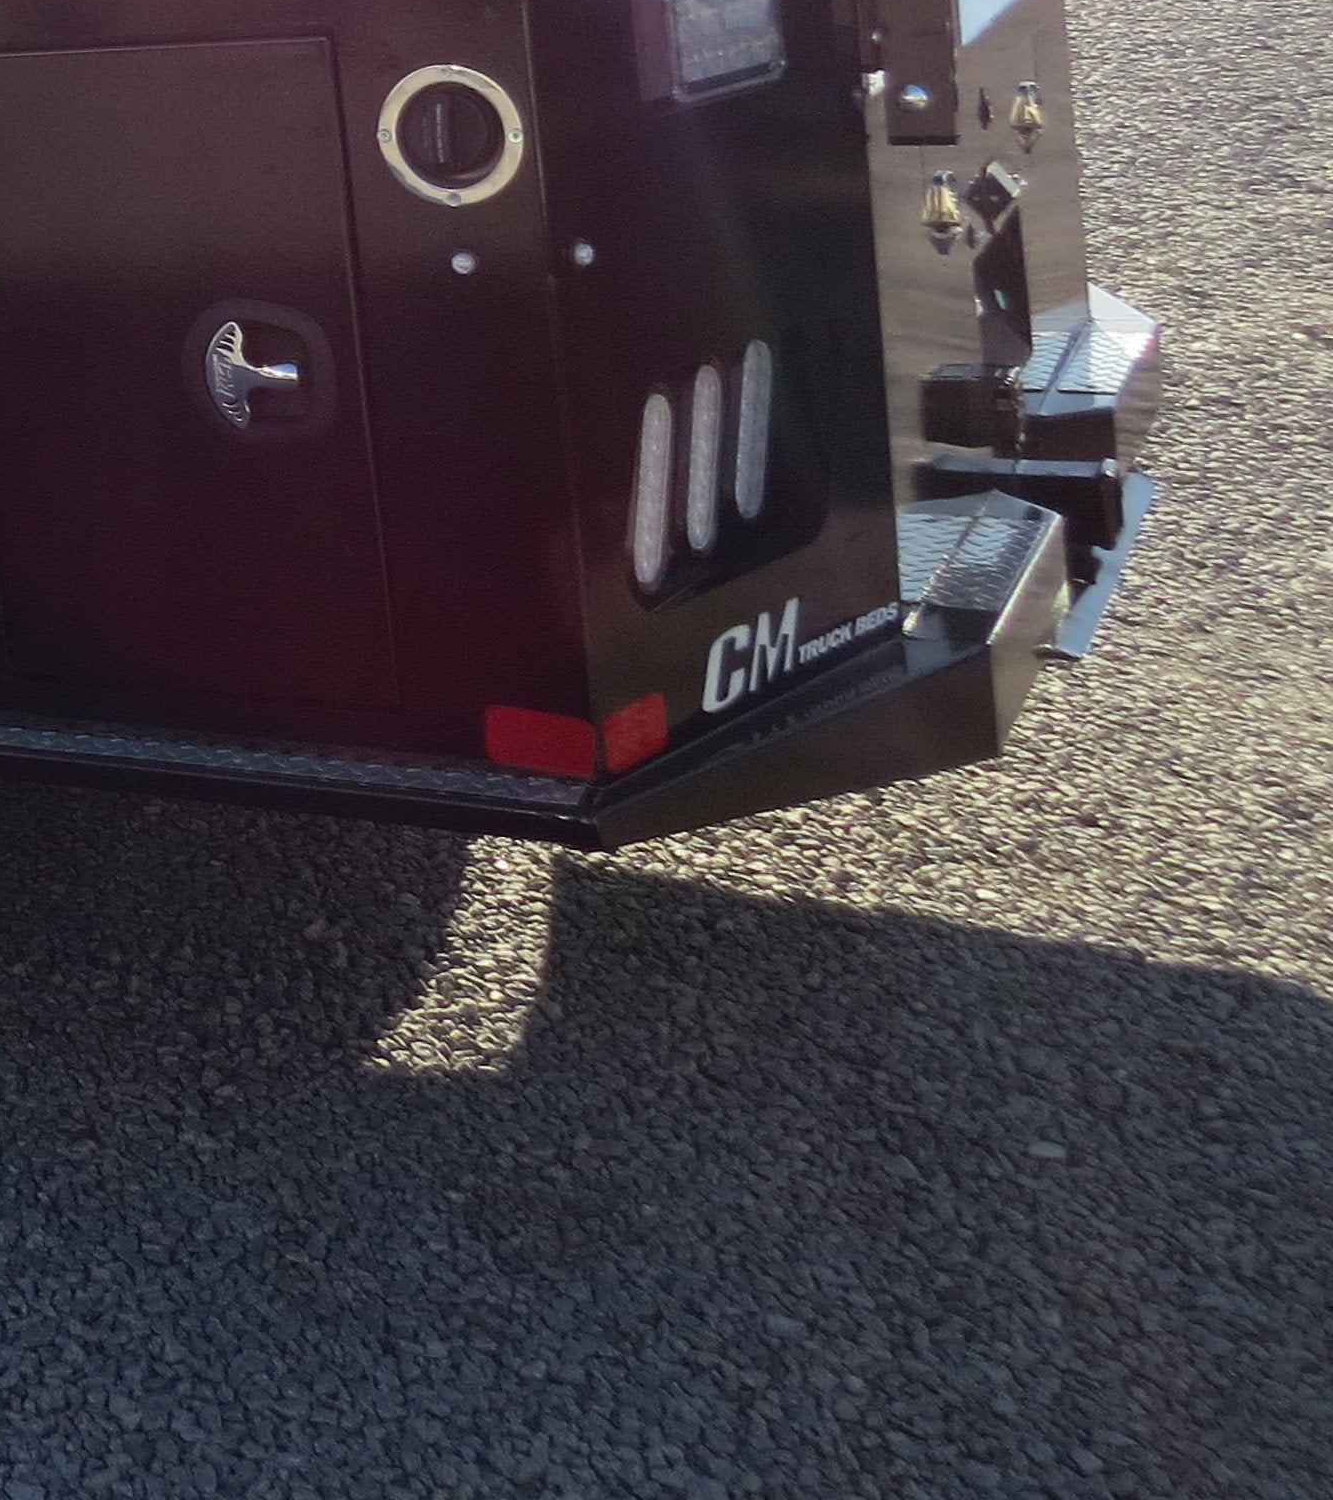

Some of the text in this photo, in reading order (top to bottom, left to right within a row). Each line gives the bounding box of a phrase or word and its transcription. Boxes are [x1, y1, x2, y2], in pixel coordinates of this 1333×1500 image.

[702, 596, 800, 713] CM
[798, 601, 899, 664] TRUCK BEDS
